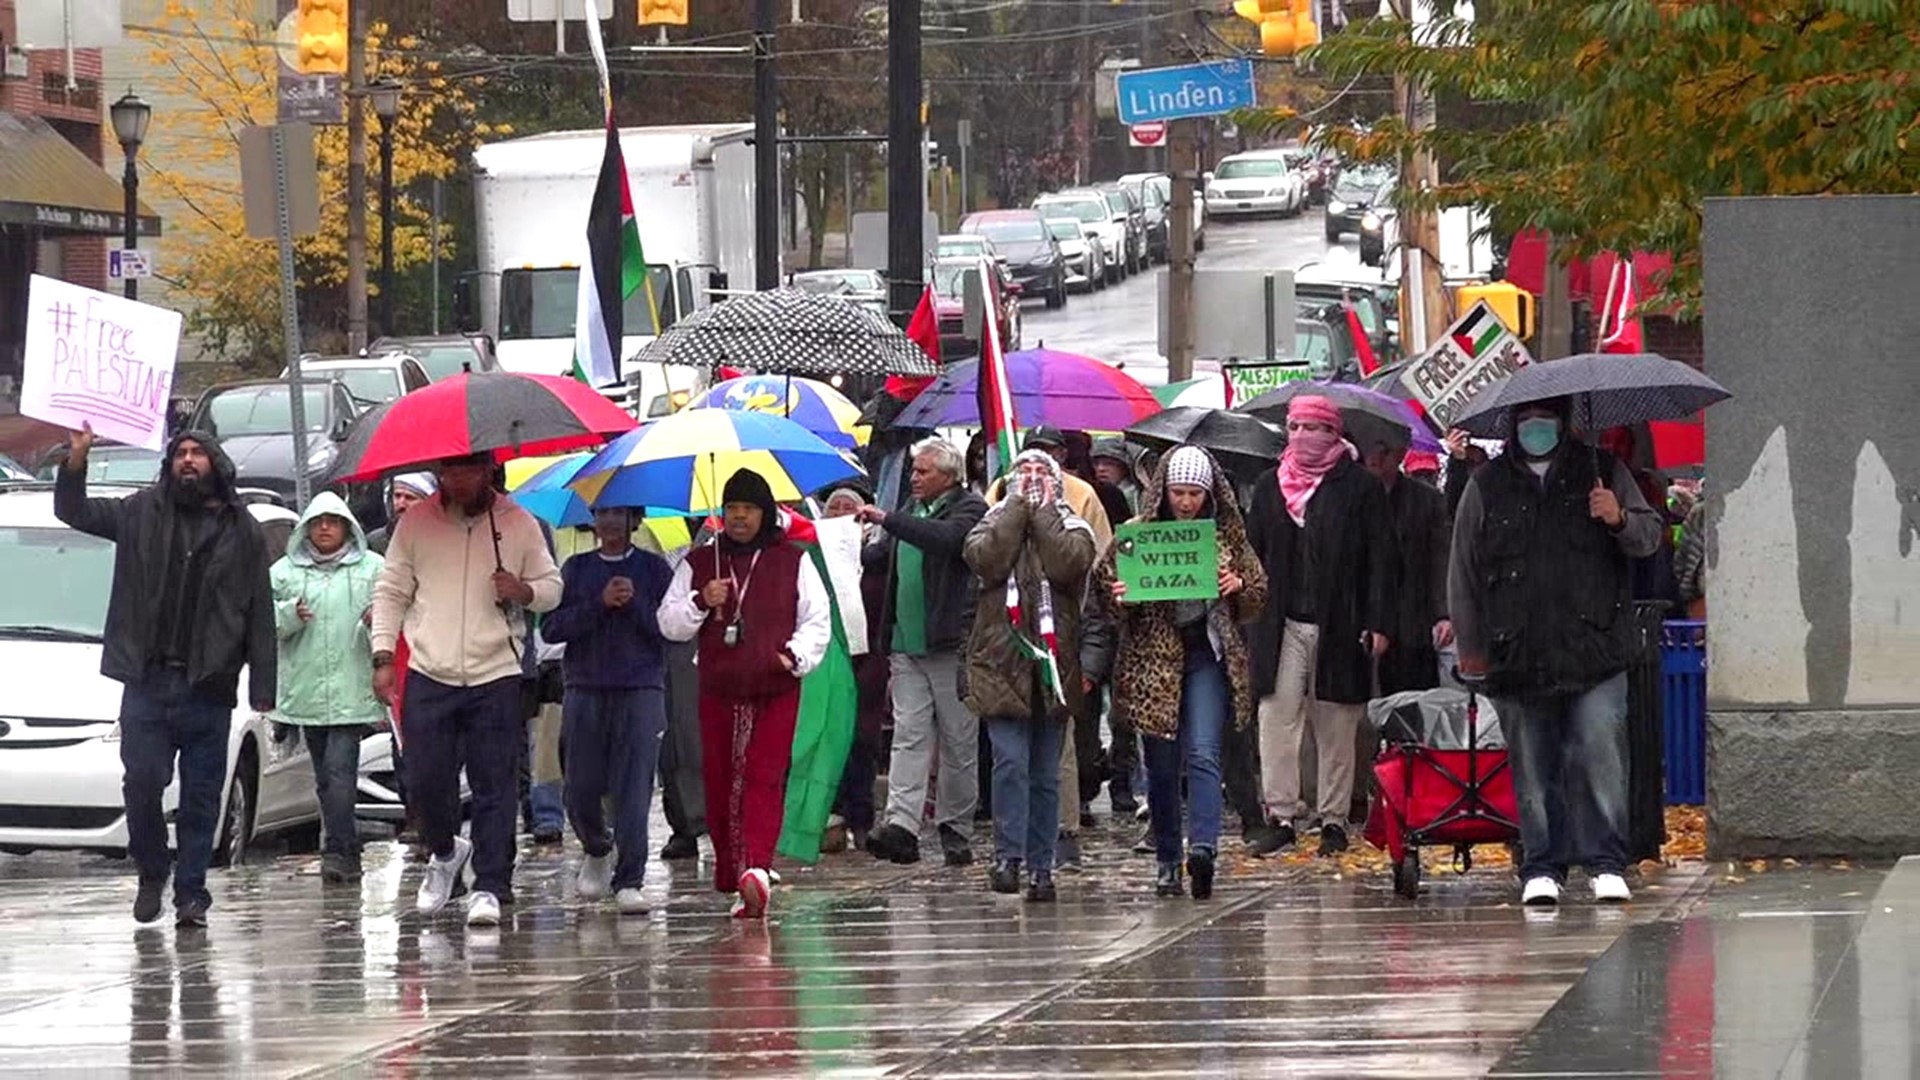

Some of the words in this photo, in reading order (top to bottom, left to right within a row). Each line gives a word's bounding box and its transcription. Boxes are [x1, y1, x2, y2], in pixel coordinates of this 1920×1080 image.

[1130, 80, 1223, 115] Linden
[52, 337, 171, 417] PALESTINE
[1412, 342, 1466, 400] FREE
[1136, 529, 1200, 544] STAND
[1141, 551, 1199, 566] WITH
[1140, 573, 1198, 588] GAZA
